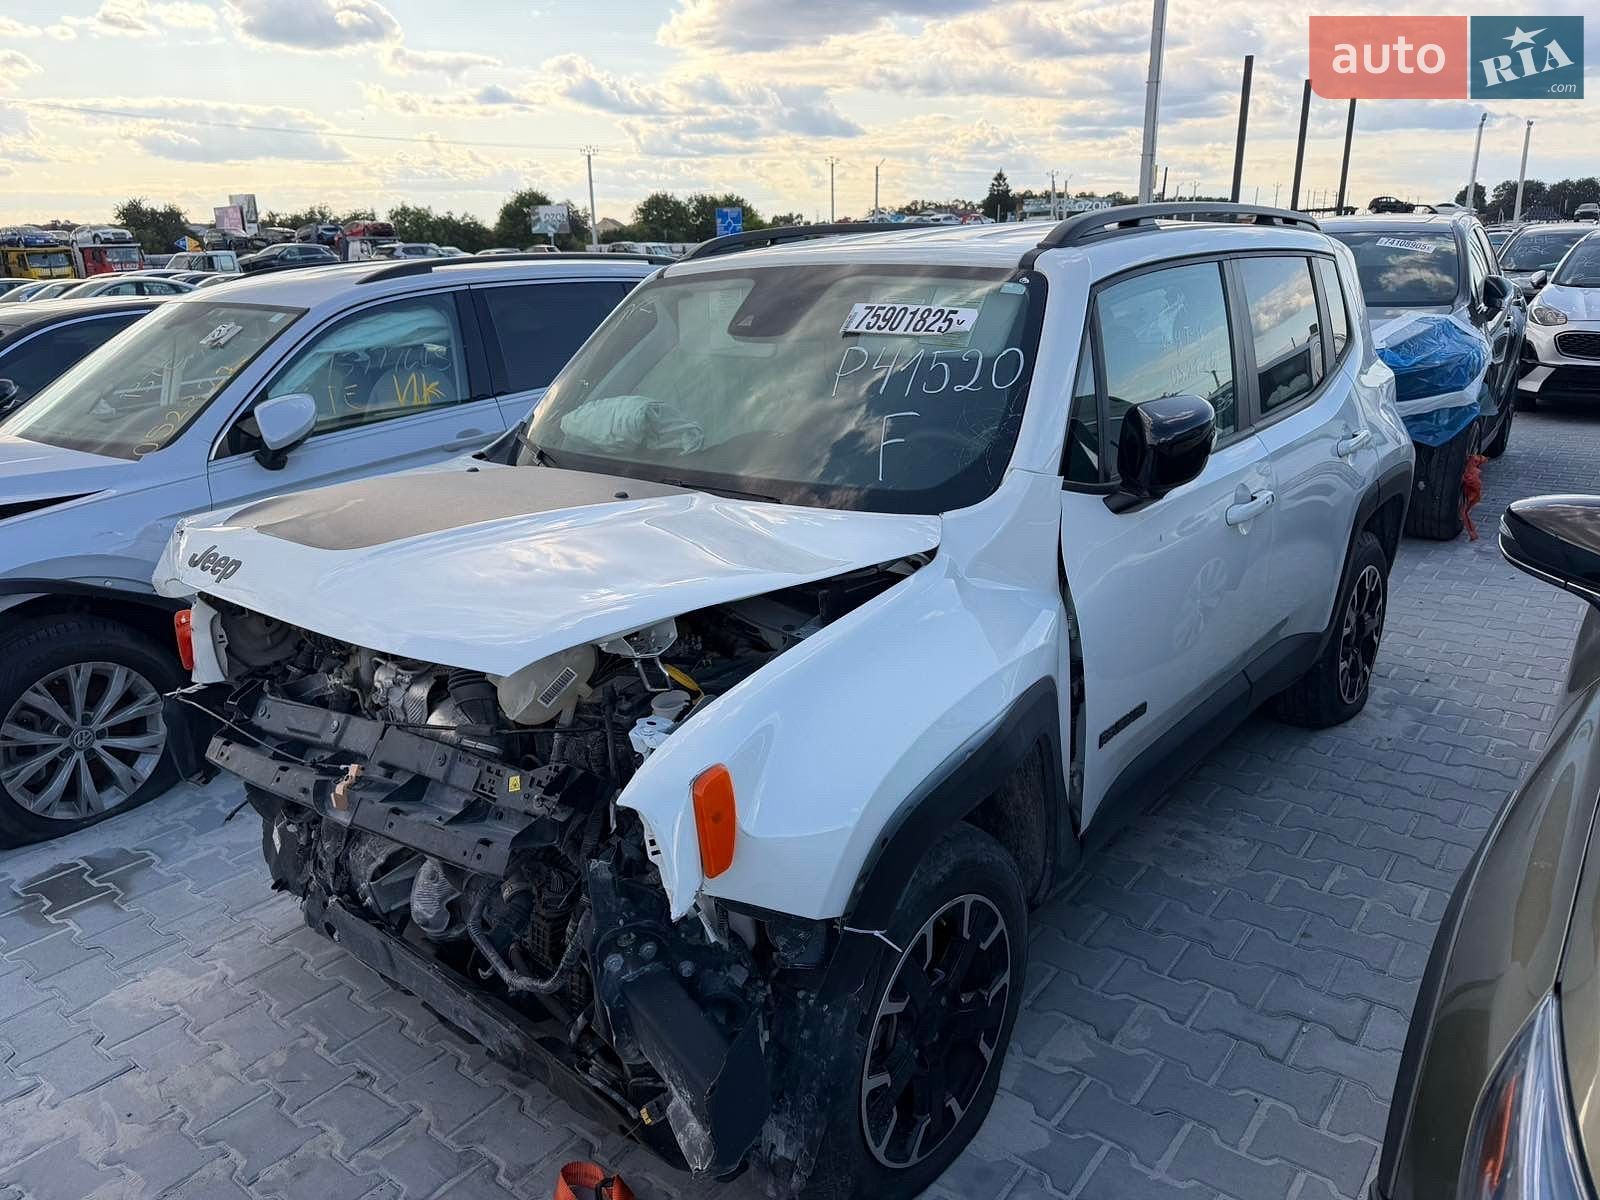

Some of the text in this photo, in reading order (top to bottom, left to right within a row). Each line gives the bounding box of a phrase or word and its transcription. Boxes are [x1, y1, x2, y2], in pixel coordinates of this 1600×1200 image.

[854, 305, 960, 334] 75901825
[831, 345, 1026, 398] P41520
[878, 411, 921, 482] F
[187, 544, 244, 584] Jeep
